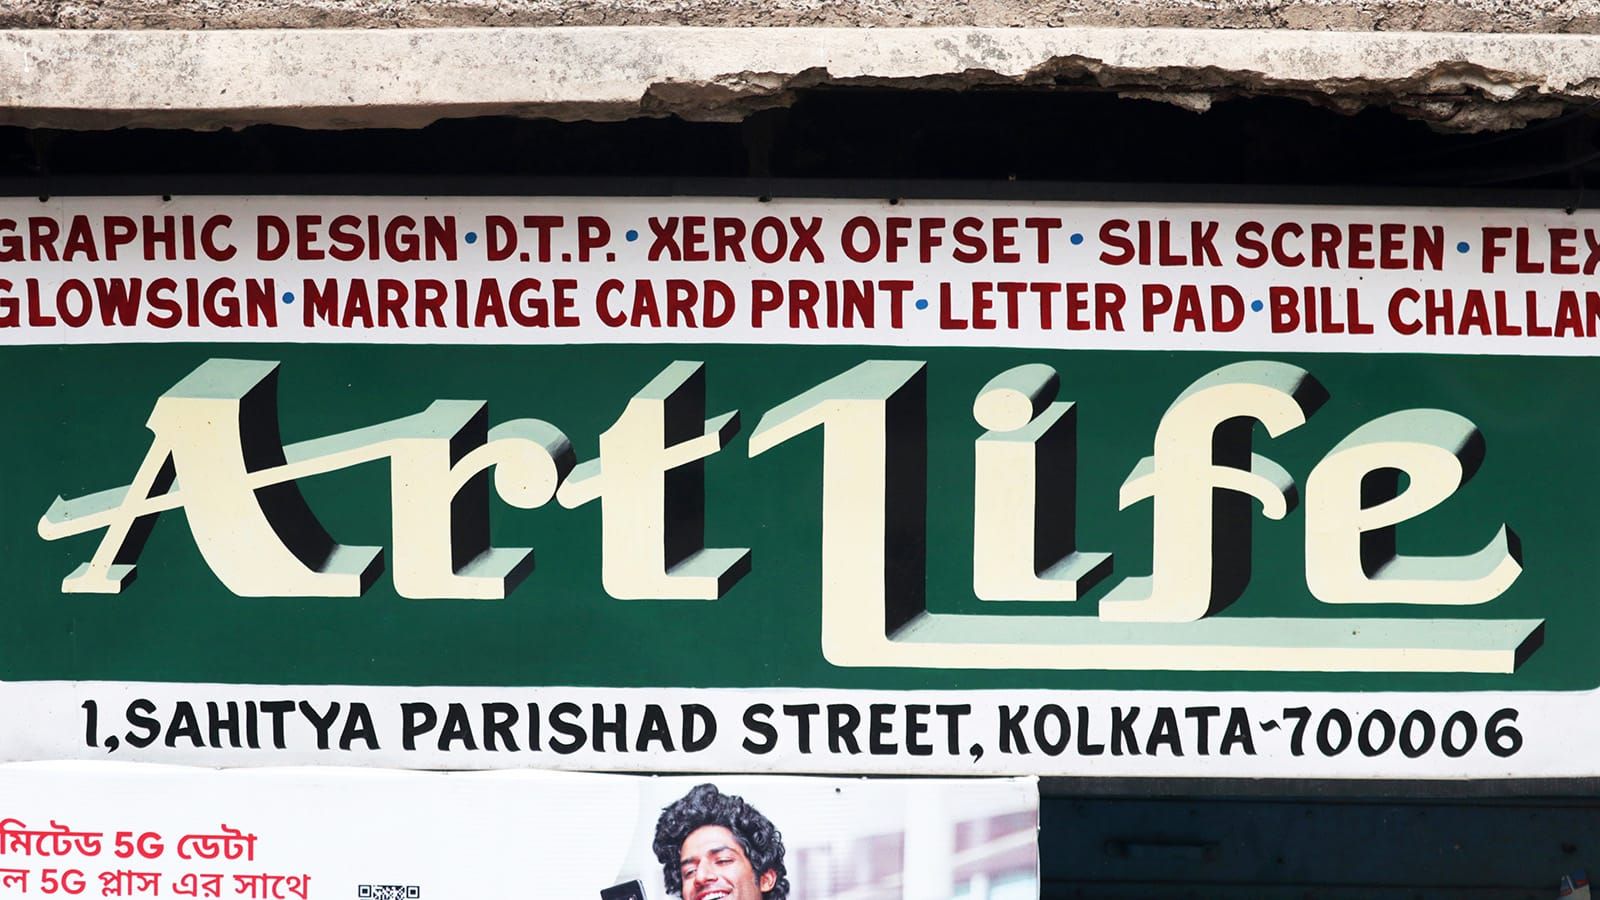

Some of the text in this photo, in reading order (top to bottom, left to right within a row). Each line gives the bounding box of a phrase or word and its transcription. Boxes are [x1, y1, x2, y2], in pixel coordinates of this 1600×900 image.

[0, 215, 236, 262] GRAPHIC
[258, 215, 458, 262] DESIGN
[487, 216, 617, 263] D.T.P.
[649, 216, 825, 263] XEROX
[842, 217, 1062, 264] OFFSET
[1100, 220, 1223, 267] SILK
[1237, 222, 1445, 271] SCREEN
[0, 278, 279, 328] GLOWSIGN
[303, 278, 581, 328] MARRIAGE
[596, 279, 737, 329] CARD
[752, 280, 914, 330] PRINT
[939, 282, 1127, 331] LETTER
[1143, 284, 1246, 332] PAD
[1269, 286, 1375, 336] BILL
[38, 358, 1545, 674] Art Life
[400, 703, 717, 754] PARISHAD
[742, 704, 984, 763] STREET,
[114, 831, 165, 860] 5G
[177, 823, 257, 861] ডেটা
[41, 868, 87, 895] 5G
[98, 869, 161, 897] প্লাস
[172, 873, 224, 898] এর
[233, 873, 311, 900] সাথে
